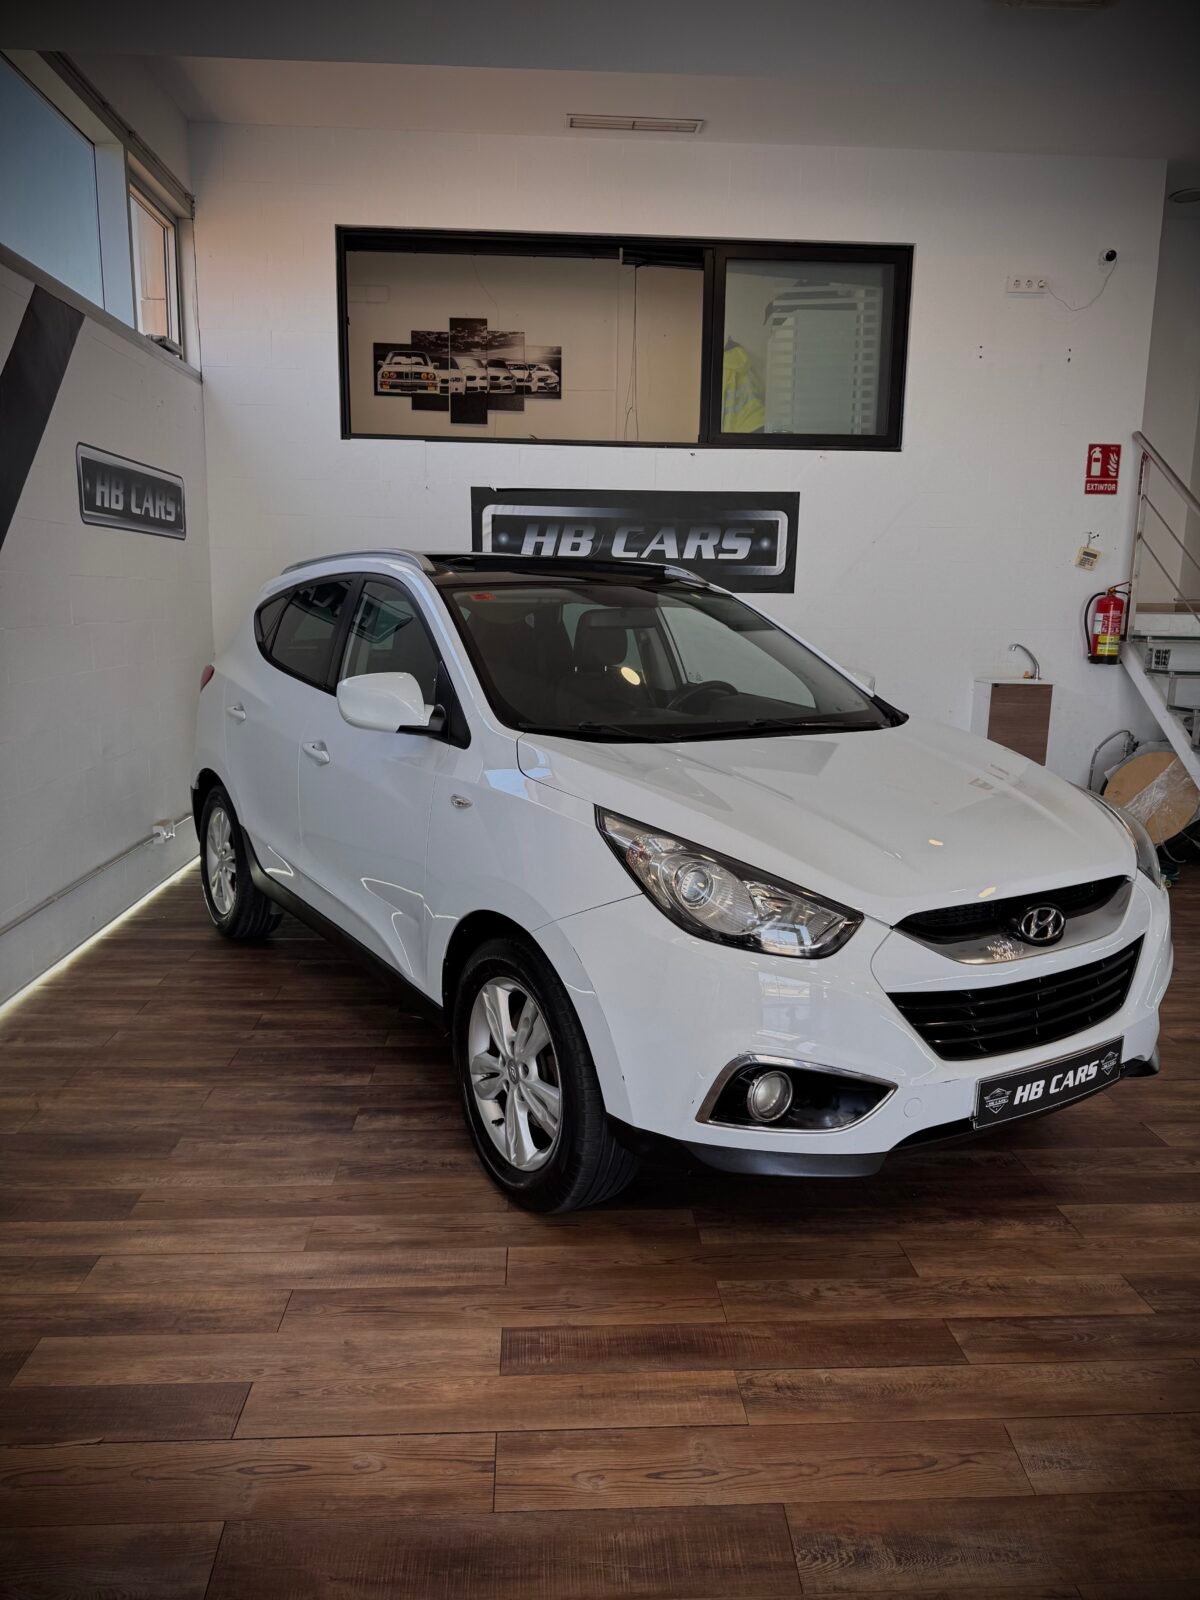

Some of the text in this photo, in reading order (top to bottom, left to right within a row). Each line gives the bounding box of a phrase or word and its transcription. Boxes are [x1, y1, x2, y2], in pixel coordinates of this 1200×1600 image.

[95, 474, 176, 522] HB CARS
[1086, 483, 1116, 491] EXTINTOR
[521, 523, 754, 560] HB CARS
[1013, 1060, 1099, 1105] HB CARS
